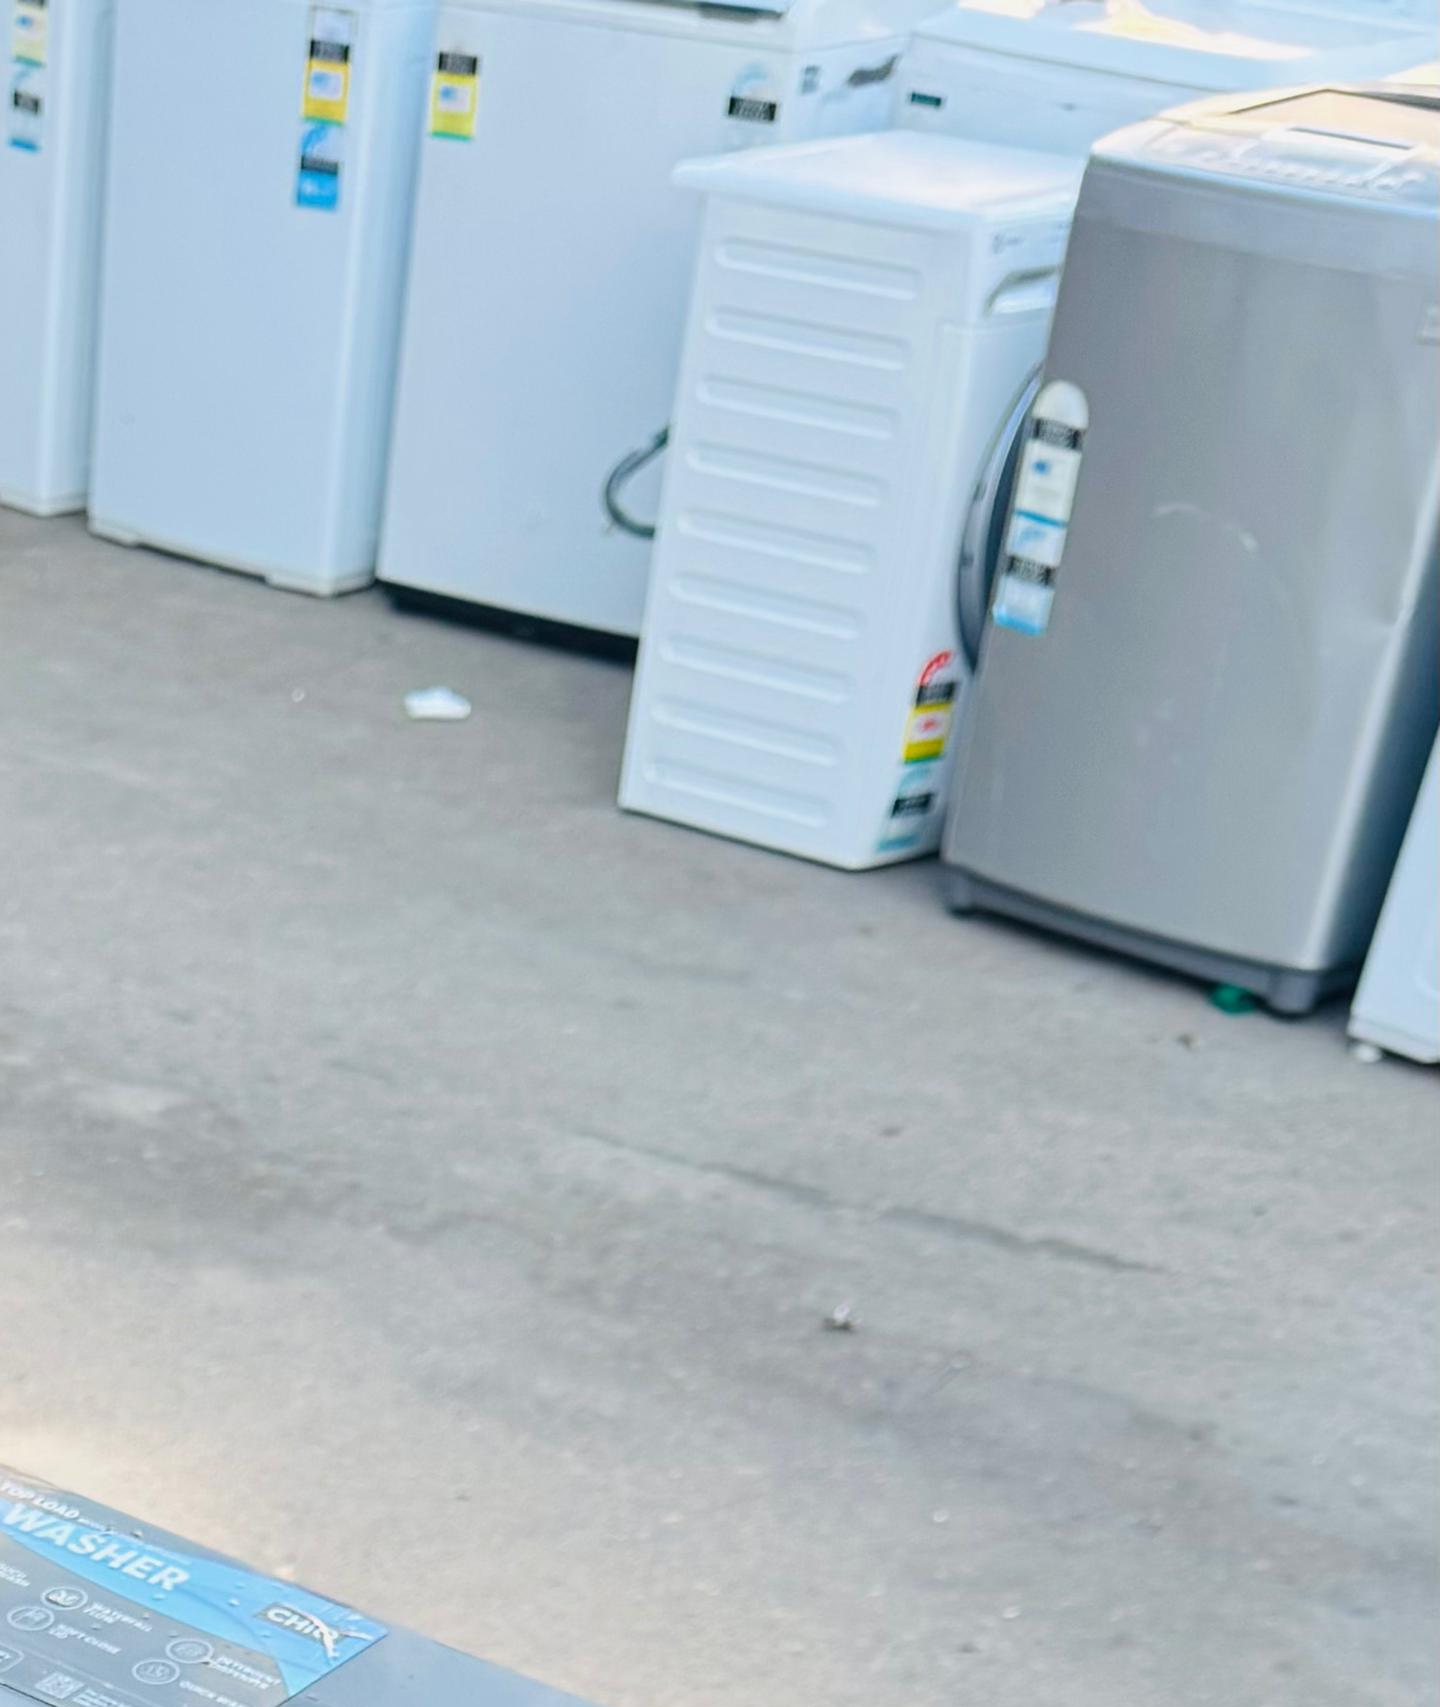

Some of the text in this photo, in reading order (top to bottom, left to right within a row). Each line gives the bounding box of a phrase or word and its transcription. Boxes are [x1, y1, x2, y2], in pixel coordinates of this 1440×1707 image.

[0, 1479, 34, 1500] TOP
[32, 1494, 80, 1519] LOAD
[3, 1503, 191, 1591] WASHER
